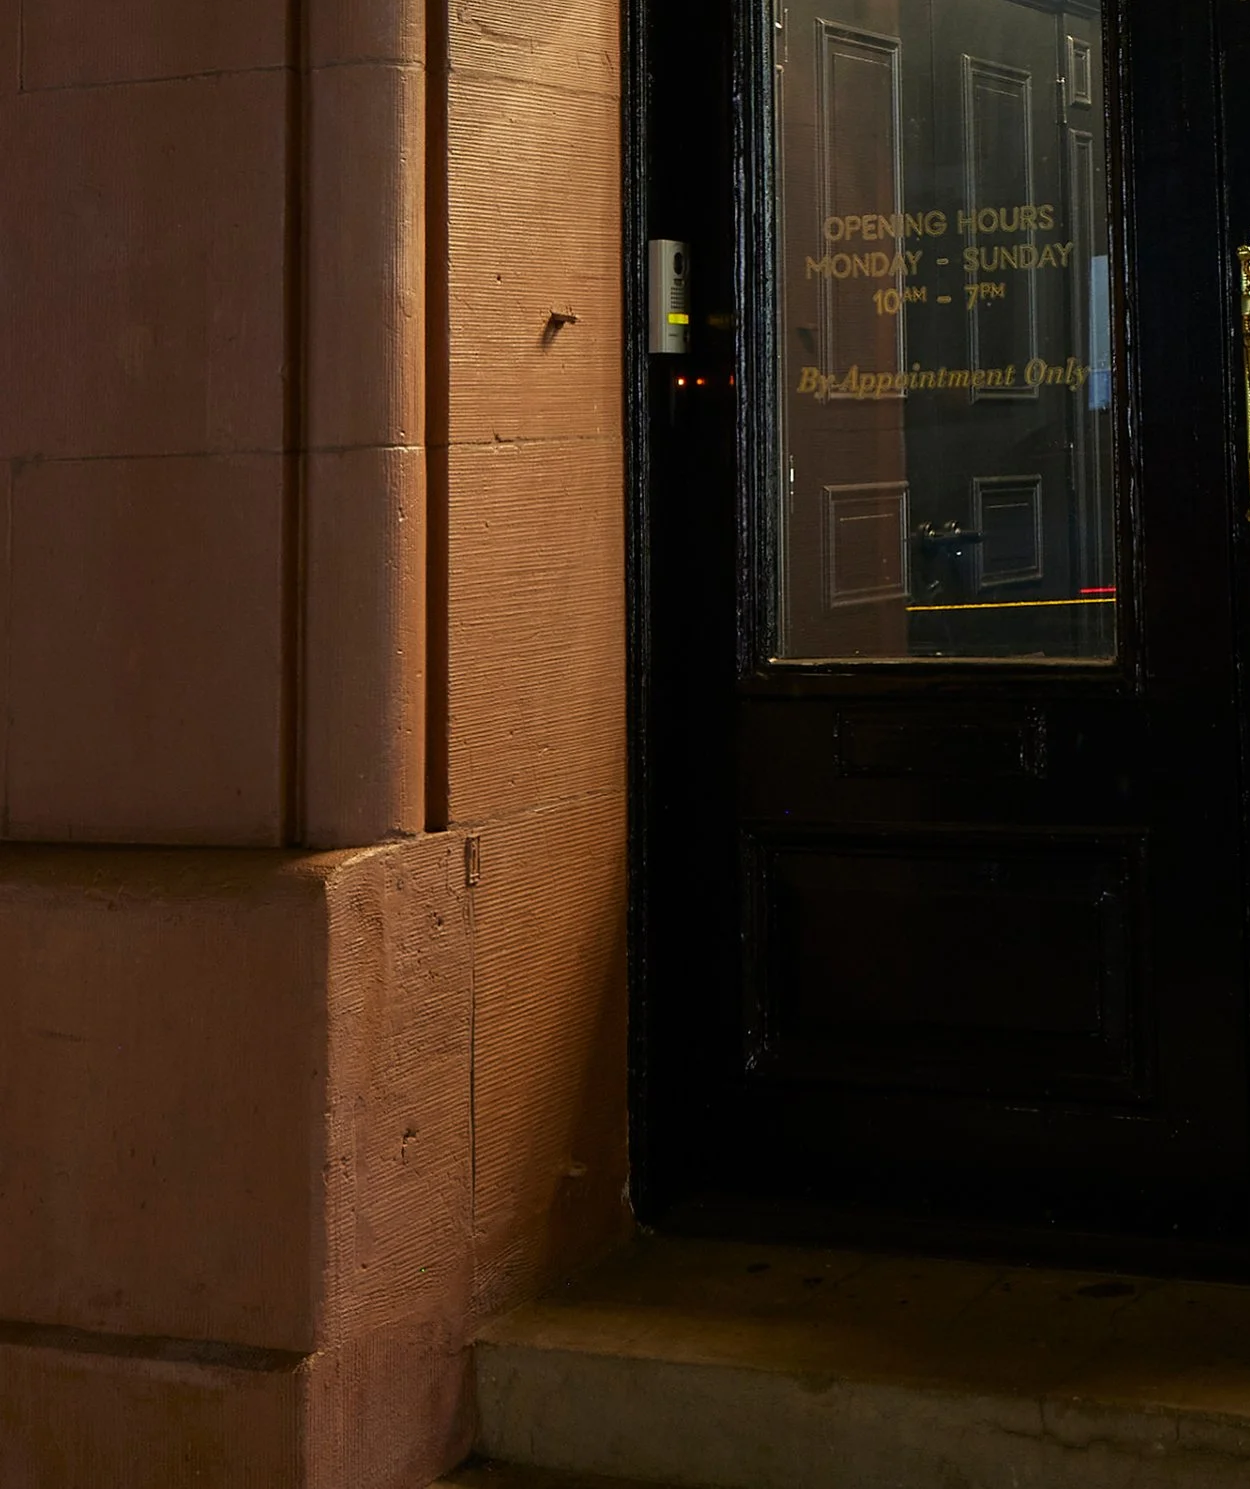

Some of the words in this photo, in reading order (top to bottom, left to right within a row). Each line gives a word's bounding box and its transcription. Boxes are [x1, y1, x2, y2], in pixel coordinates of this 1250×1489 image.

[825, 212, 947, 241] OPENING
[958, 205, 1054, 234] HOURS
[806, 251, 922, 279] MONDAY
[936, 258, 949, 266] -
[964, 242, 1074, 273] SUNDAY
[873, 287, 928, 315] 10AM
[936, 296, 951, 304] -
[964, 283, 1005, 310] 7PM
[796, 366, 831, 403] By
[831, 362, 1016, 400] Appointment
[1024, 356, 1089, 392] Only
